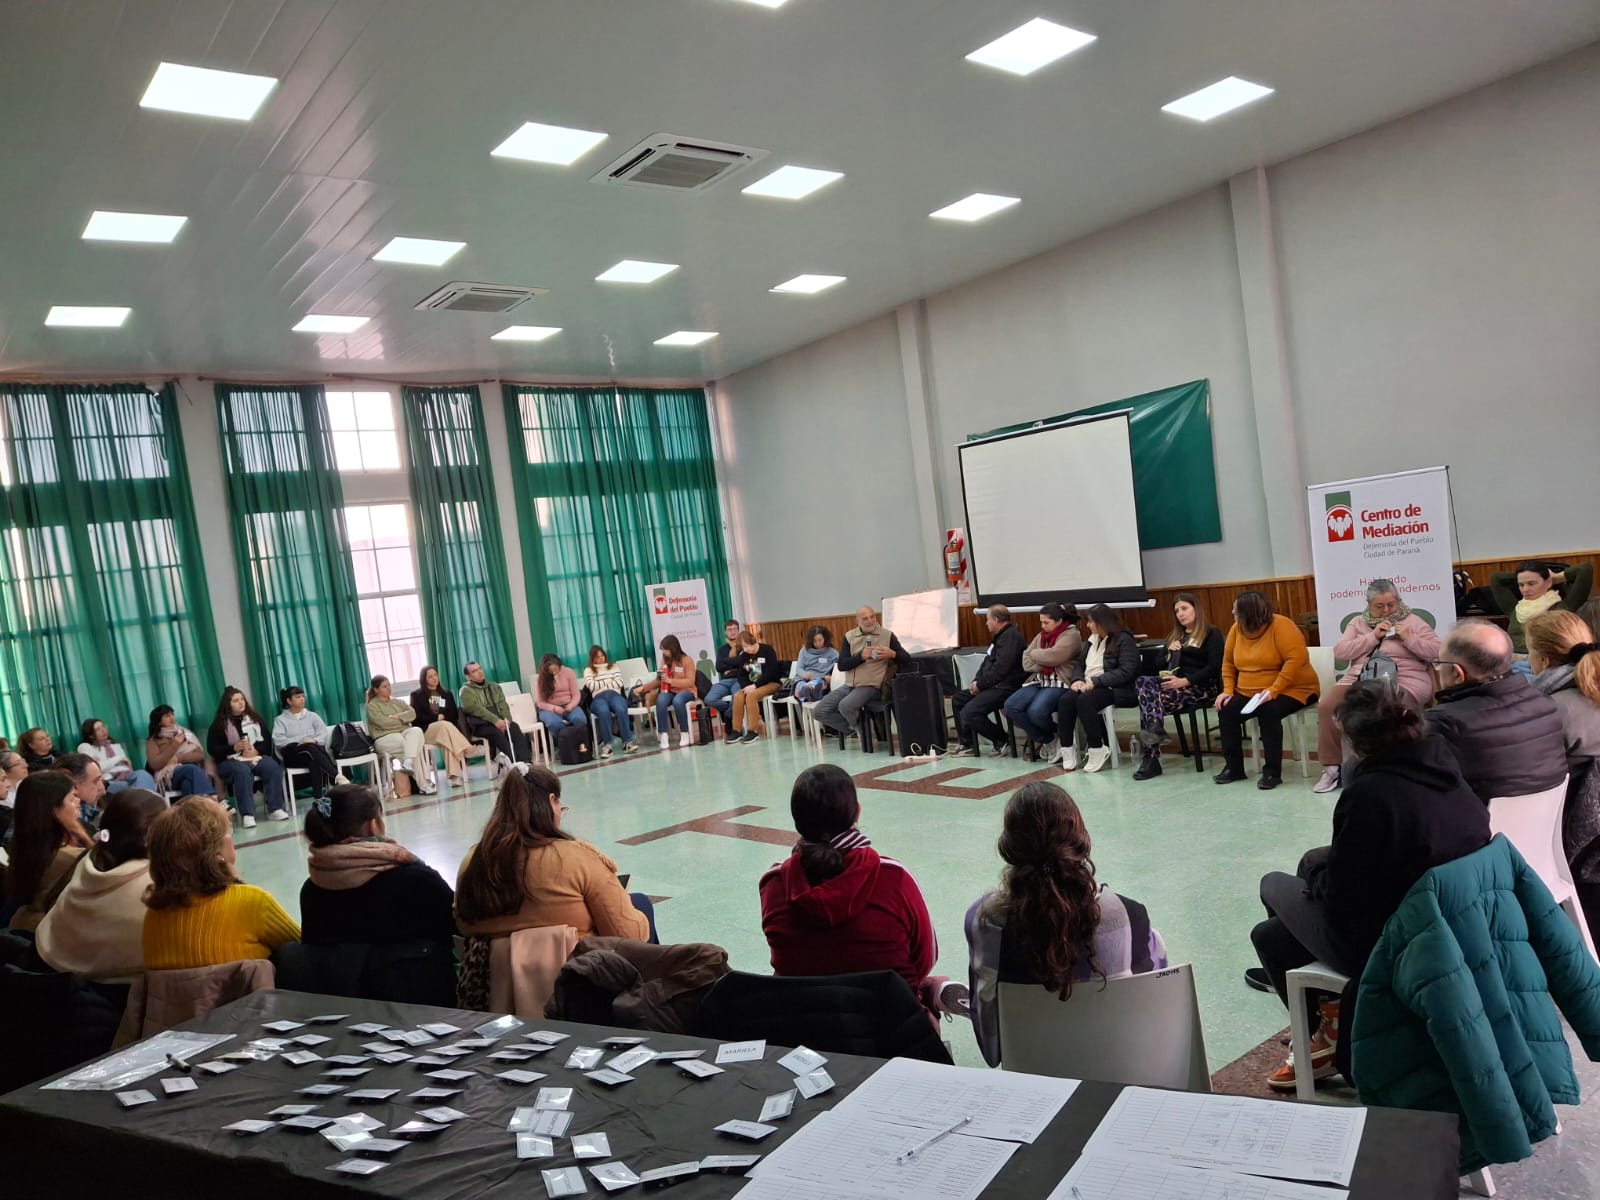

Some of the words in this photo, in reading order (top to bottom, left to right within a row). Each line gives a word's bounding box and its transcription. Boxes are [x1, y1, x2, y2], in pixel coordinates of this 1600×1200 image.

[1361, 509, 1401, 522] Centro
[1404, 504, 1421, 518] de
[1362, 521, 1429, 539] Mediación
[1398, 538, 1409, 548] del
[1410, 535, 1434, 546] Pueblo
[1363, 548, 1386, 559] Ciudad
[1387, 549, 1396, 557] de
